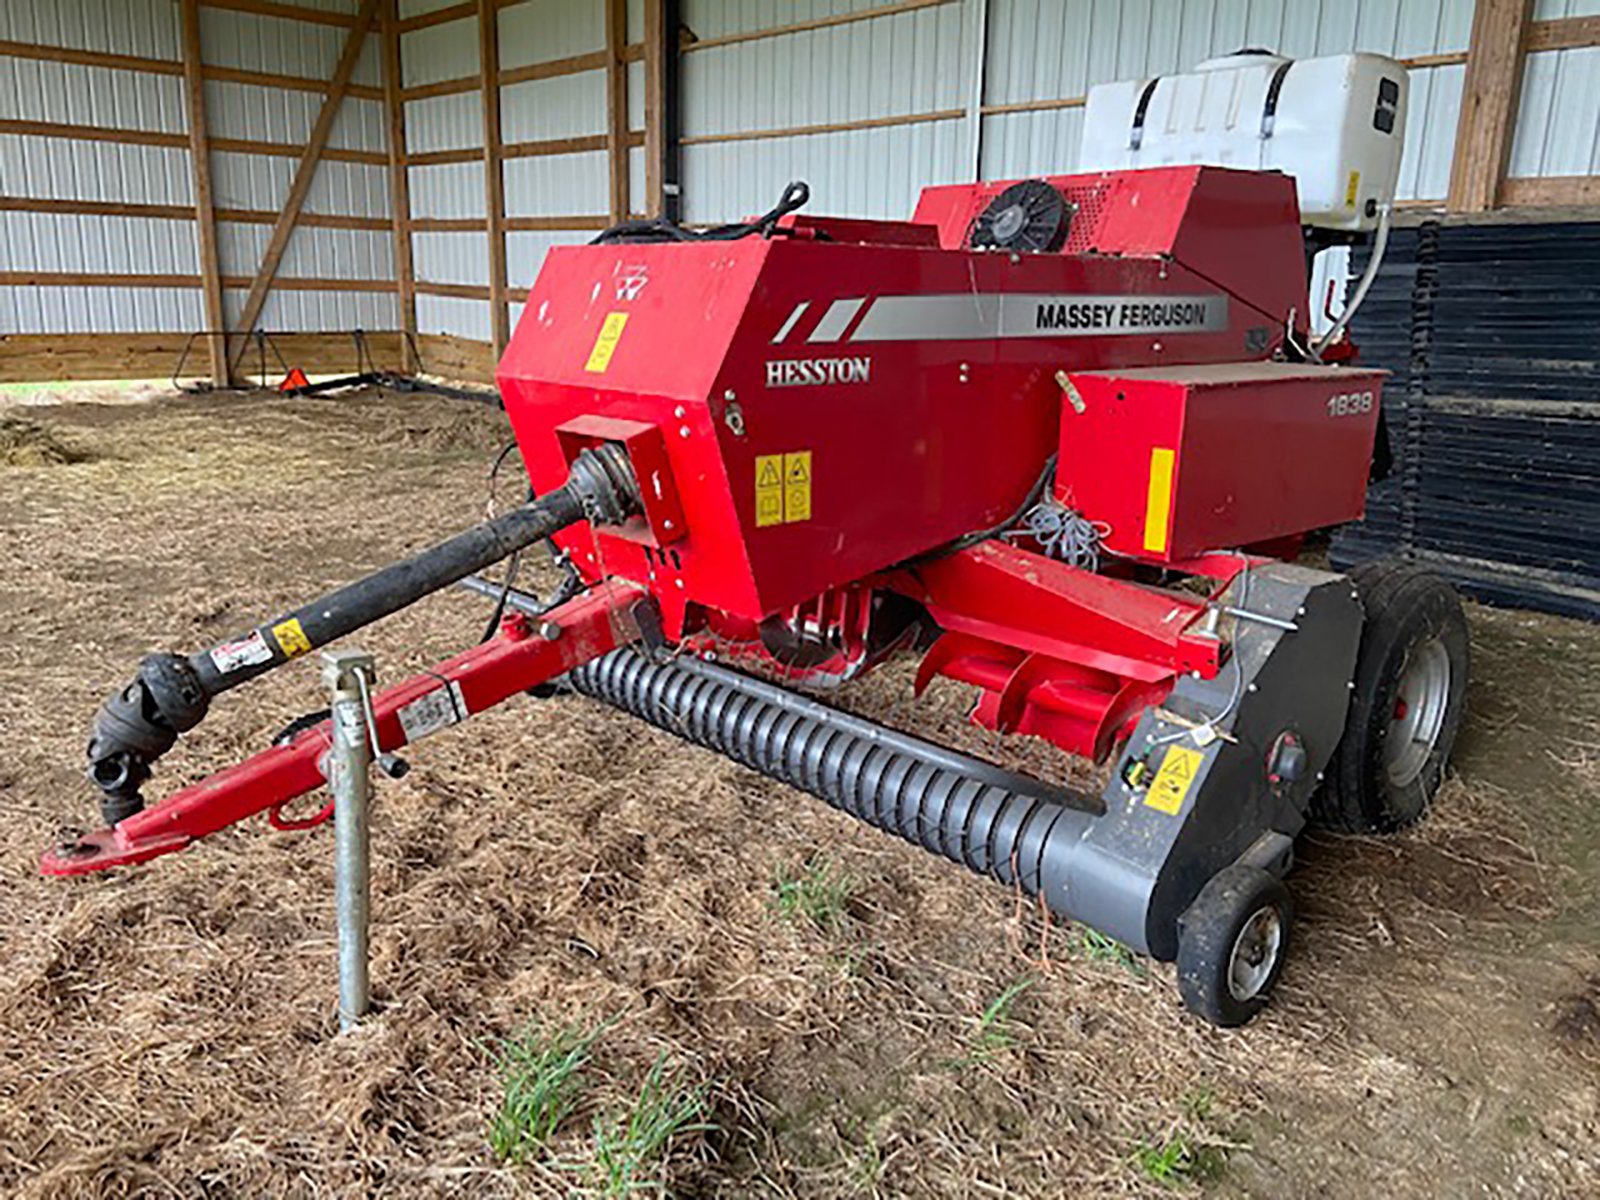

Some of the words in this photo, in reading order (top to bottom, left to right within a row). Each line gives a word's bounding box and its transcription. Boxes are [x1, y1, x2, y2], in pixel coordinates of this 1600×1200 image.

[1036, 304, 1115, 329] MASSEY
[1119, 303, 1206, 327] FERGUSON
[765, 357, 871, 388] HESSTON
[1327, 391, 1373, 417] 1838
